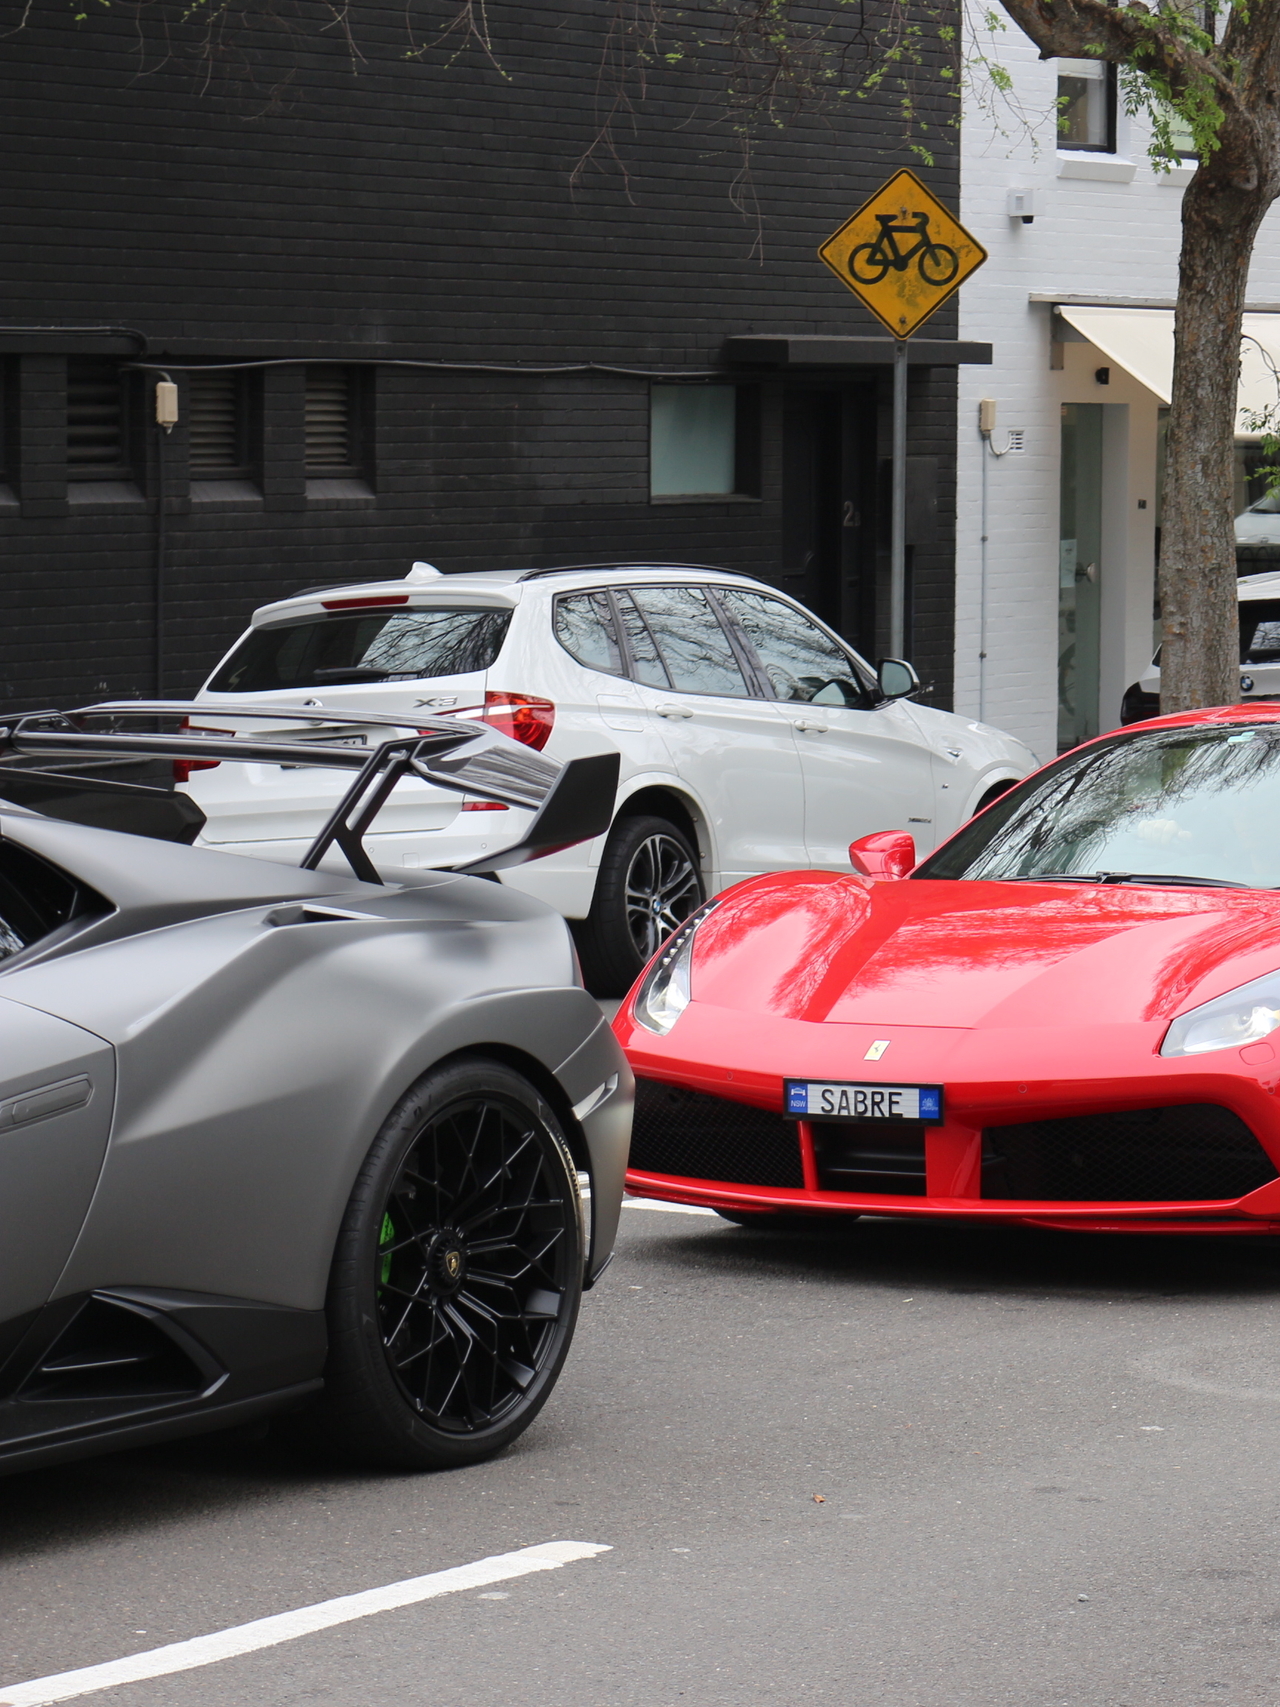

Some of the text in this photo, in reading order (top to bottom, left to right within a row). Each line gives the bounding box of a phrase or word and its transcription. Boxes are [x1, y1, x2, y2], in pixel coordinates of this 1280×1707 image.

[413, 696, 458, 708] X3
[790, 1100, 806, 1108] NSW
[820, 1088, 904, 1118] SABRE
